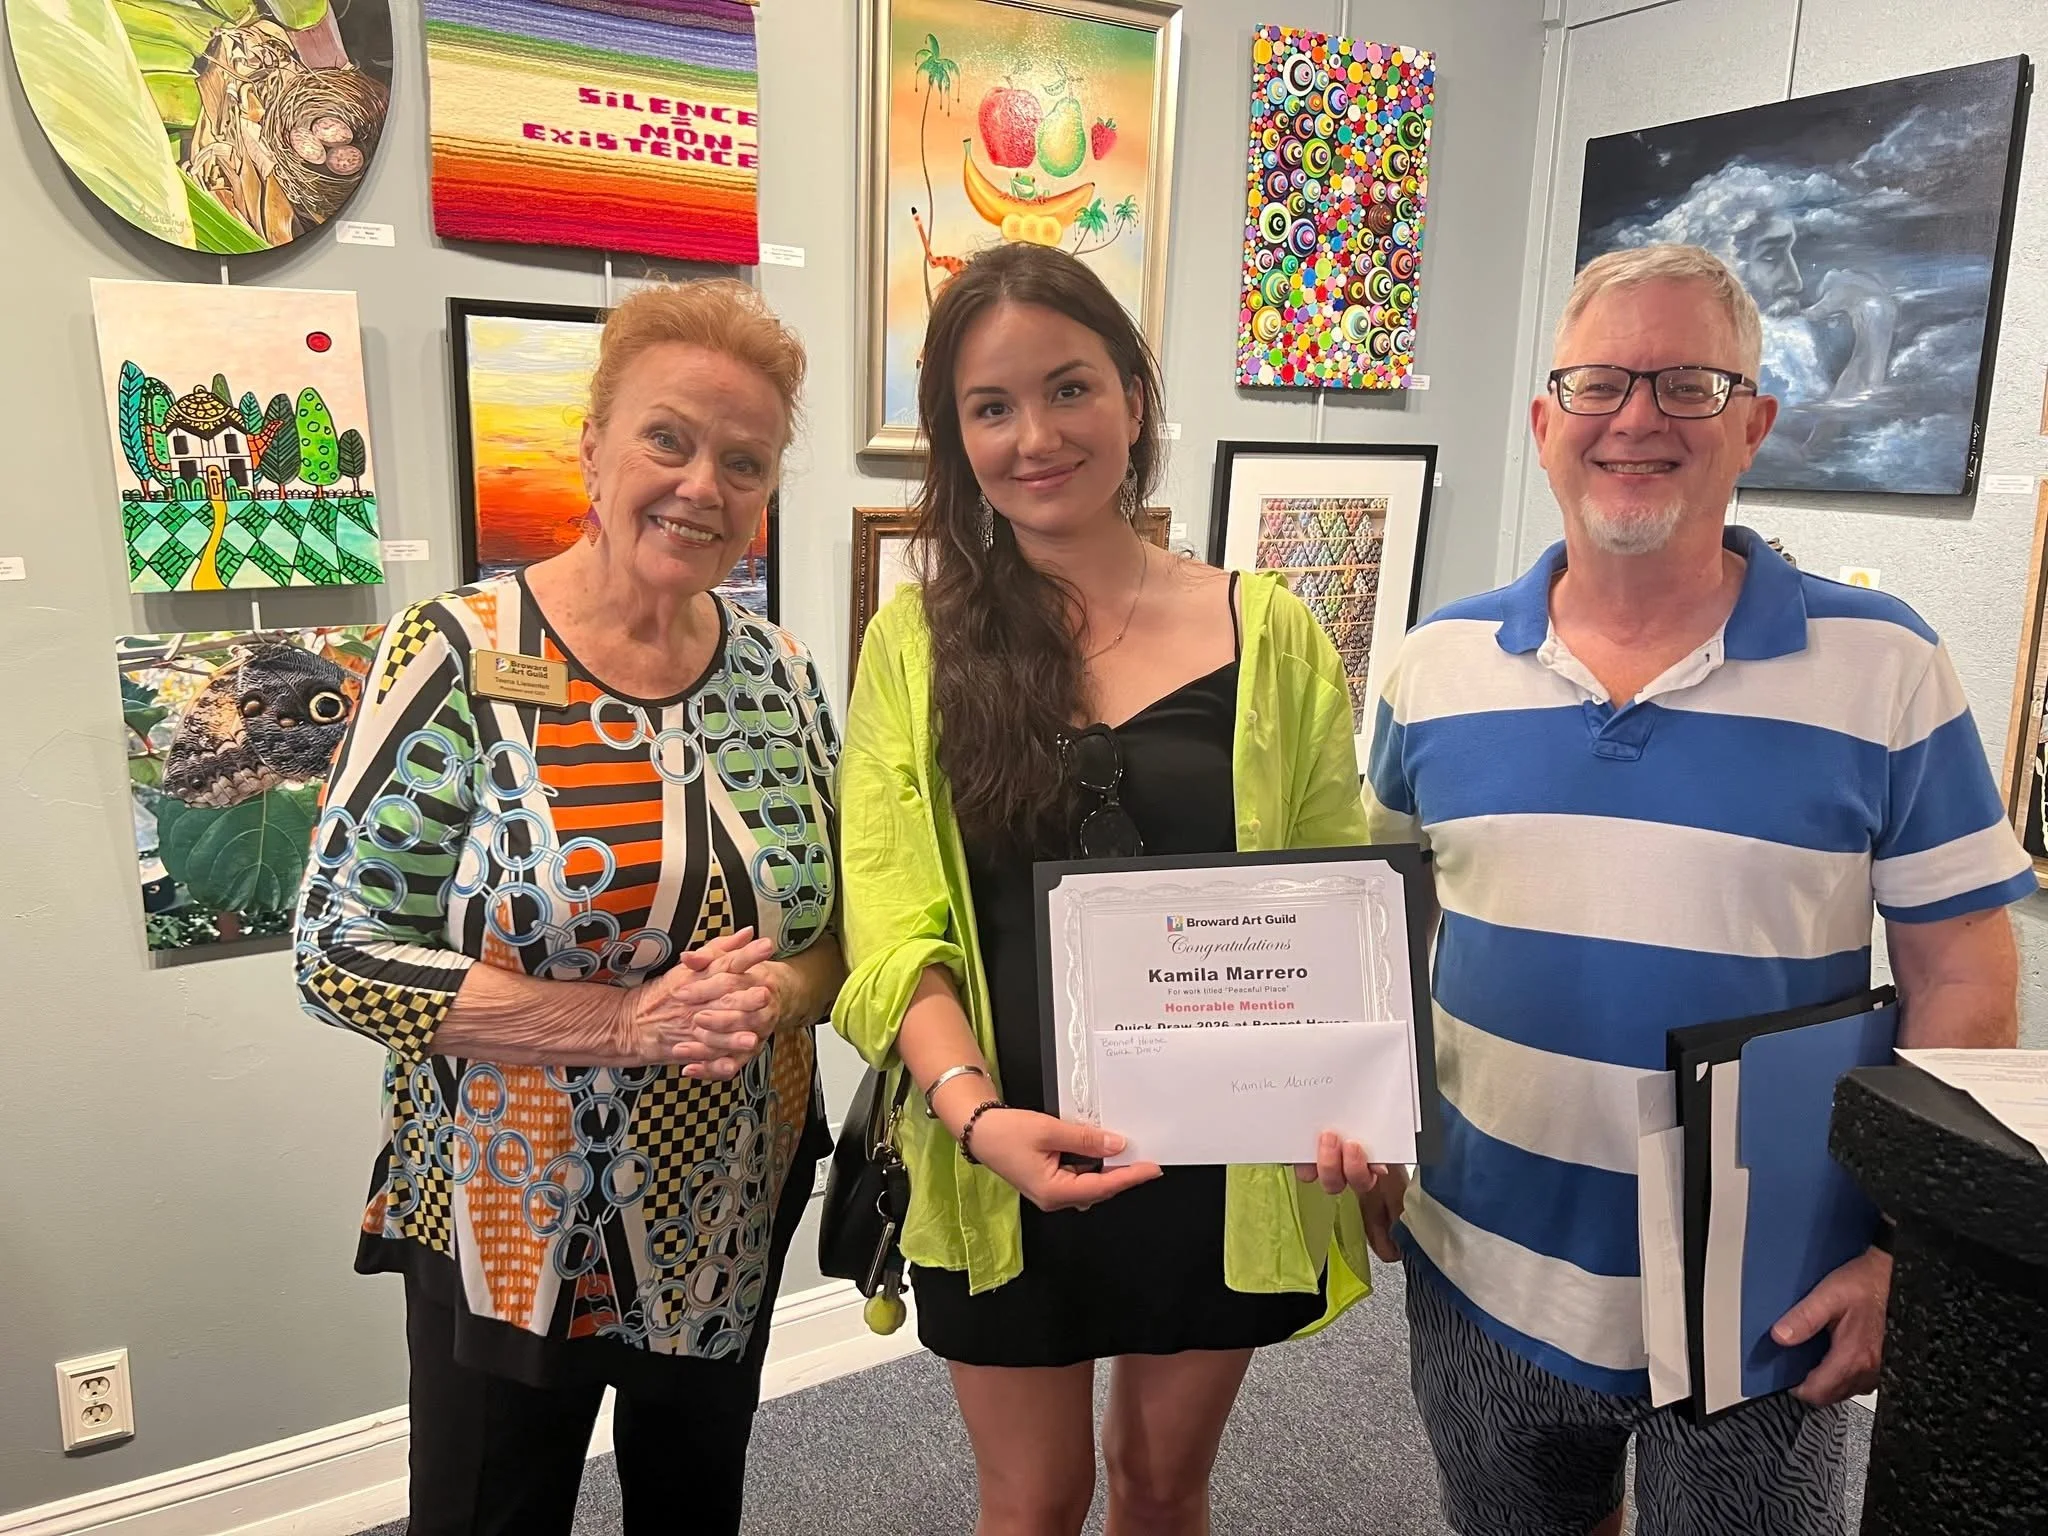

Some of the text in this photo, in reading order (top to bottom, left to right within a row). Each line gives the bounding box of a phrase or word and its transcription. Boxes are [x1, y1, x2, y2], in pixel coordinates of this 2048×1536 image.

[511, 660, 548, 672] Broward
[511, 668, 548, 679] Art Guild
[1186, 916, 1239, 928] Broward
[1242, 915, 1262, 926] Art
[1264, 914, 1297, 925] Guild
[1167, 933, 1292, 961] Congratulations
[1148, 966, 1308, 983] Kamila Marrero
[1168, 988, 1180, 996] For
[1165, 1000, 1295, 1013] Honorable Mention
